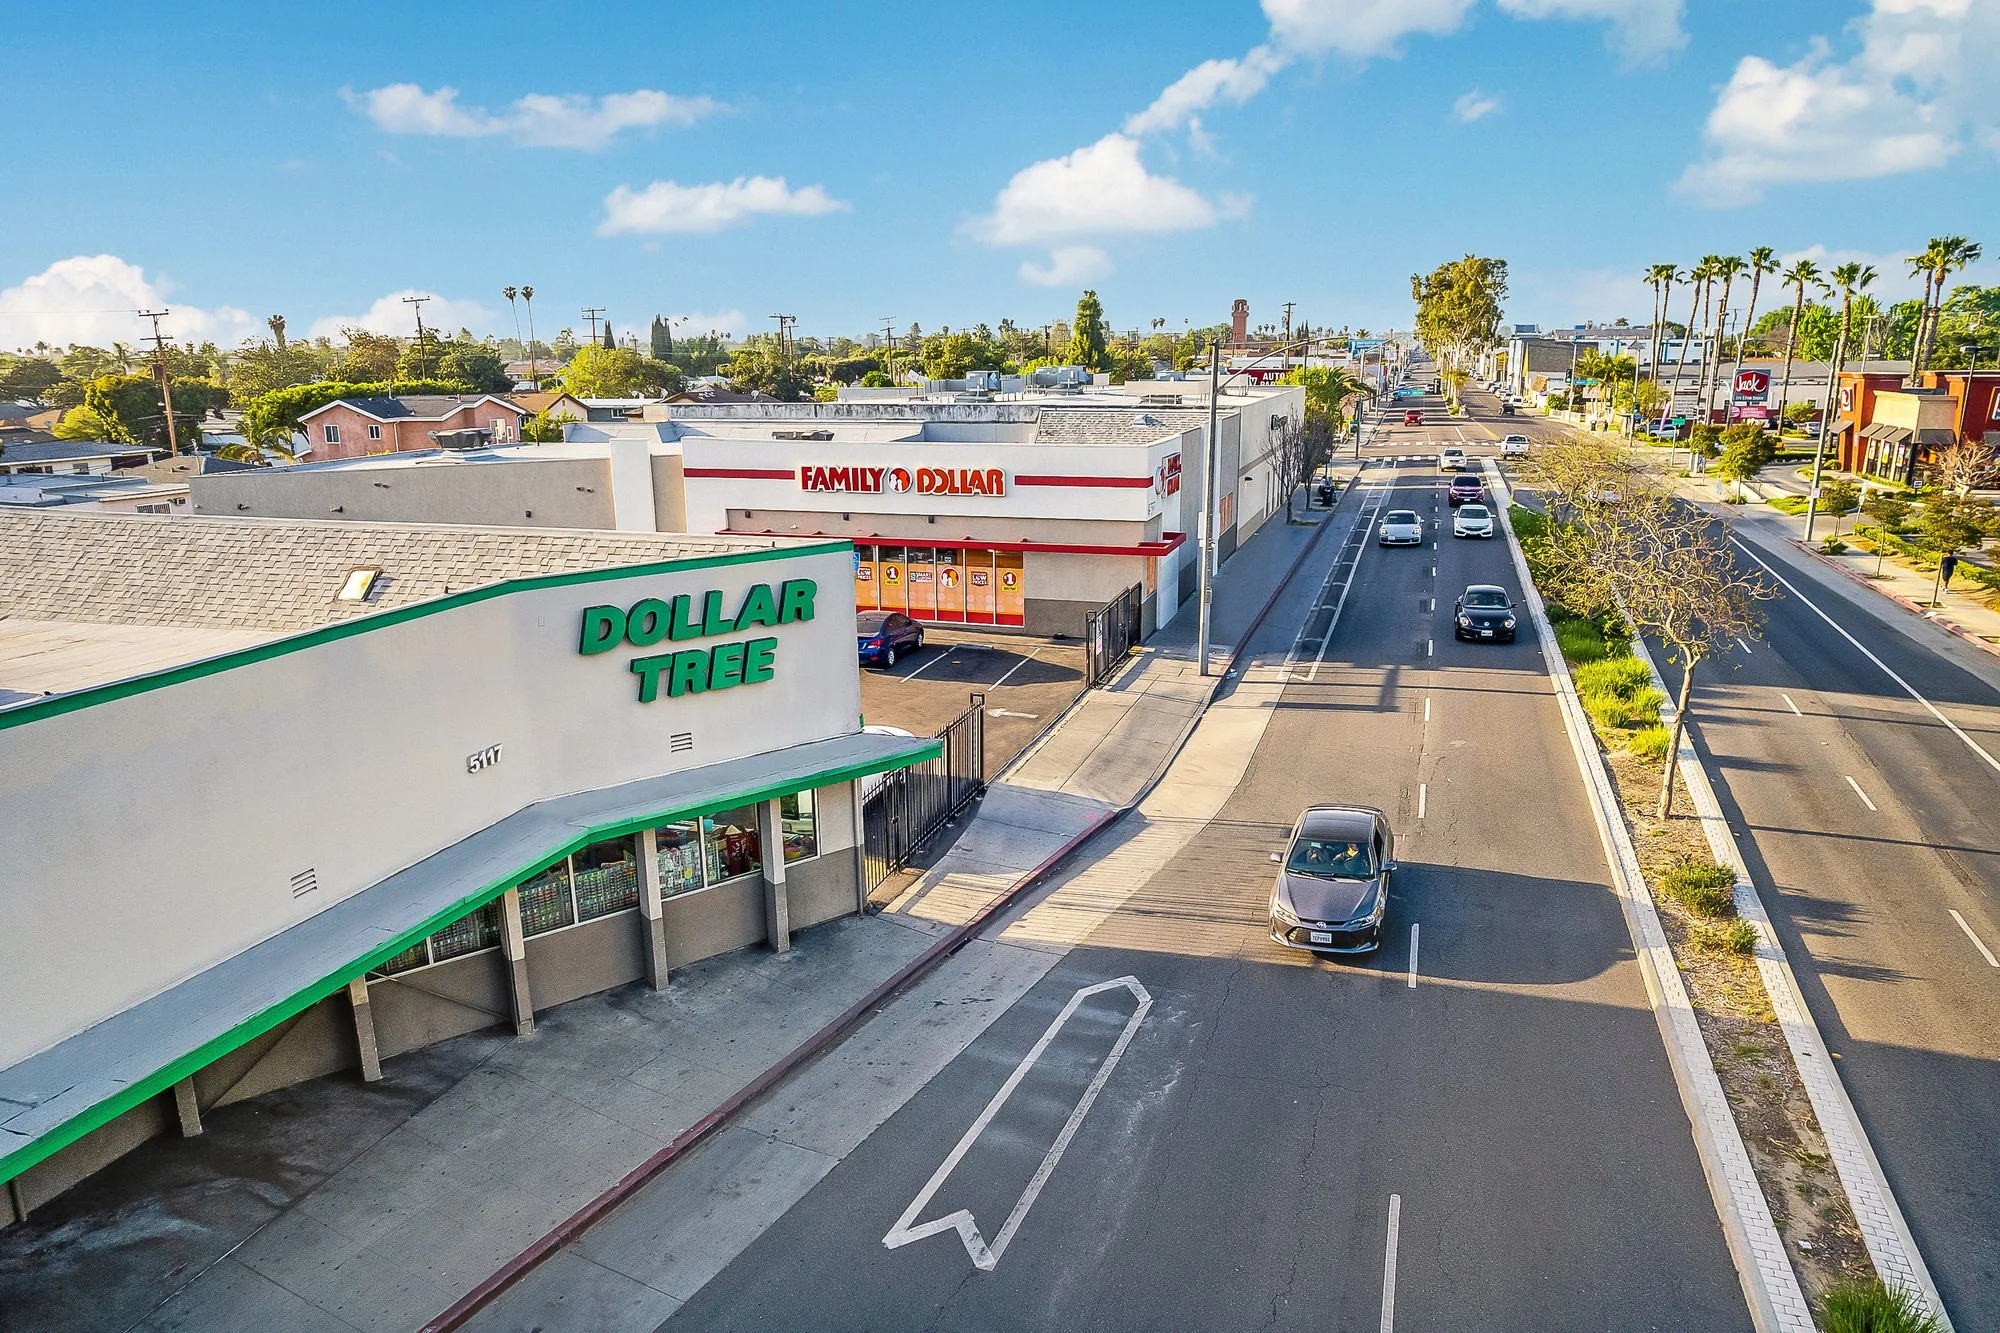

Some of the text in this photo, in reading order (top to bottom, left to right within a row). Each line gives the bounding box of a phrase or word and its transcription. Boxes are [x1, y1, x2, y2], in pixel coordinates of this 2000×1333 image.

[1262, 372, 1285, 381] AUTO
[1735, 373, 1767, 392] Jack
[801, 466, 1004, 495] FAMILY DOLLAR
[579, 578, 818, 656] DOLLAR
[630, 636, 779, 703] TREE
[467, 743, 504, 774] 5117
